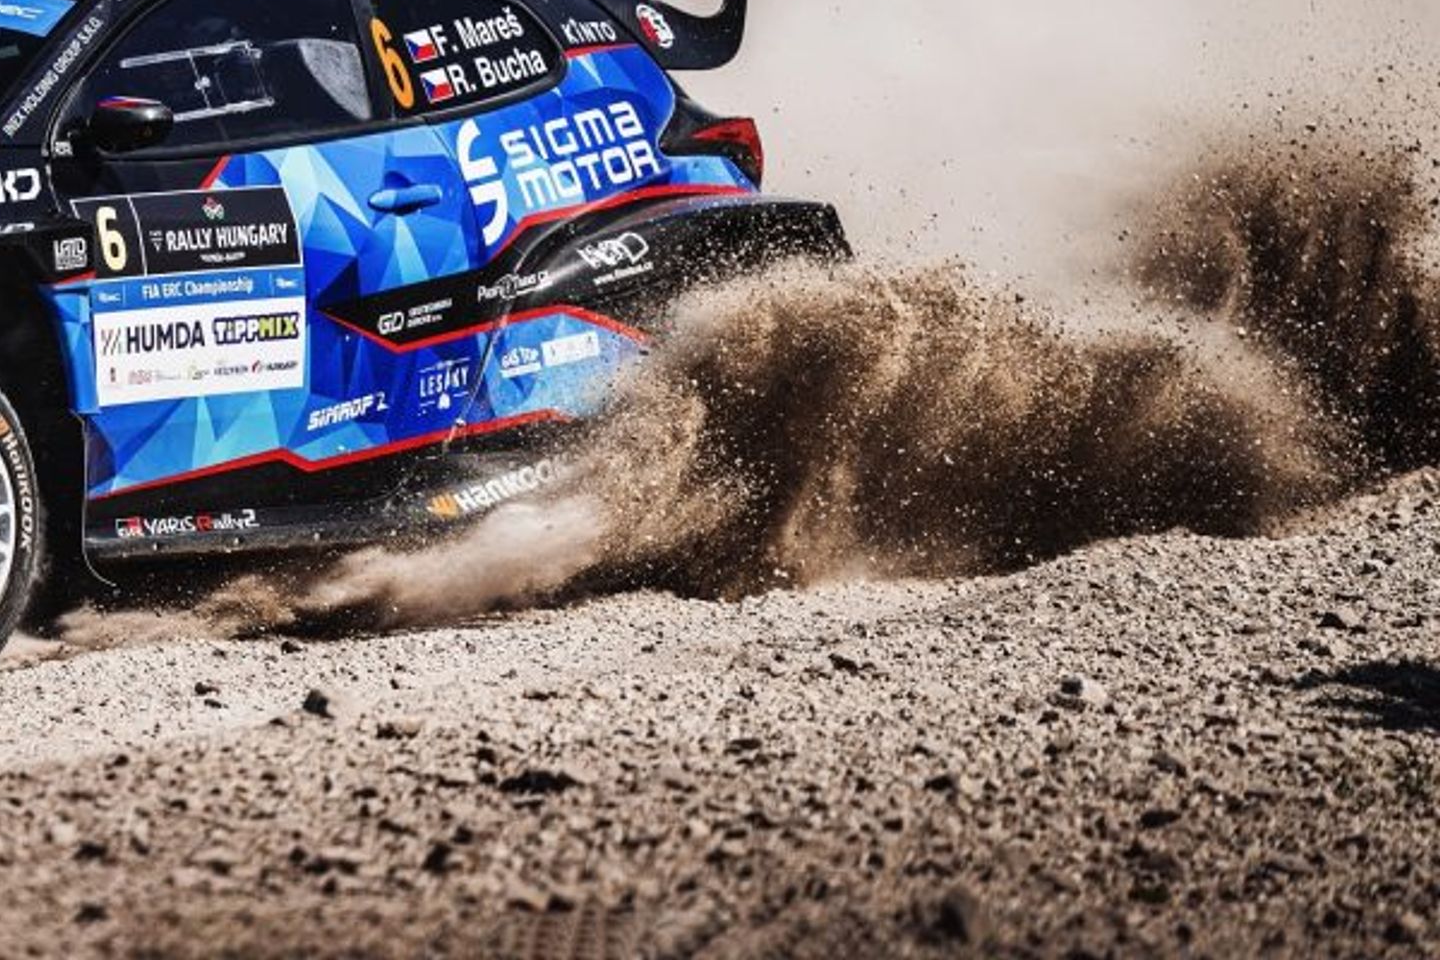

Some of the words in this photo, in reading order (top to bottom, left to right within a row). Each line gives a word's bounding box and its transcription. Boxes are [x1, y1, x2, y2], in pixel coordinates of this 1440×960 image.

[430, 24, 459, 57] F.
[454, 6, 524, 50] Mareš
[371, 16, 414, 109] 6
[446, 63, 477, 96] R.
[474, 47, 548, 88] Bucha
[516, 139, 661, 209] MOTOR
[96, 206, 127, 271] 6
[166, 229, 212, 252] RALLY
[216, 223, 288, 247] HUNGARY
[142, 283, 160, 300] FIA
[184, 276, 254, 296] Championship
[126, 321, 205, 354] HUMDA
[143, 515, 197, 535] YARIS
